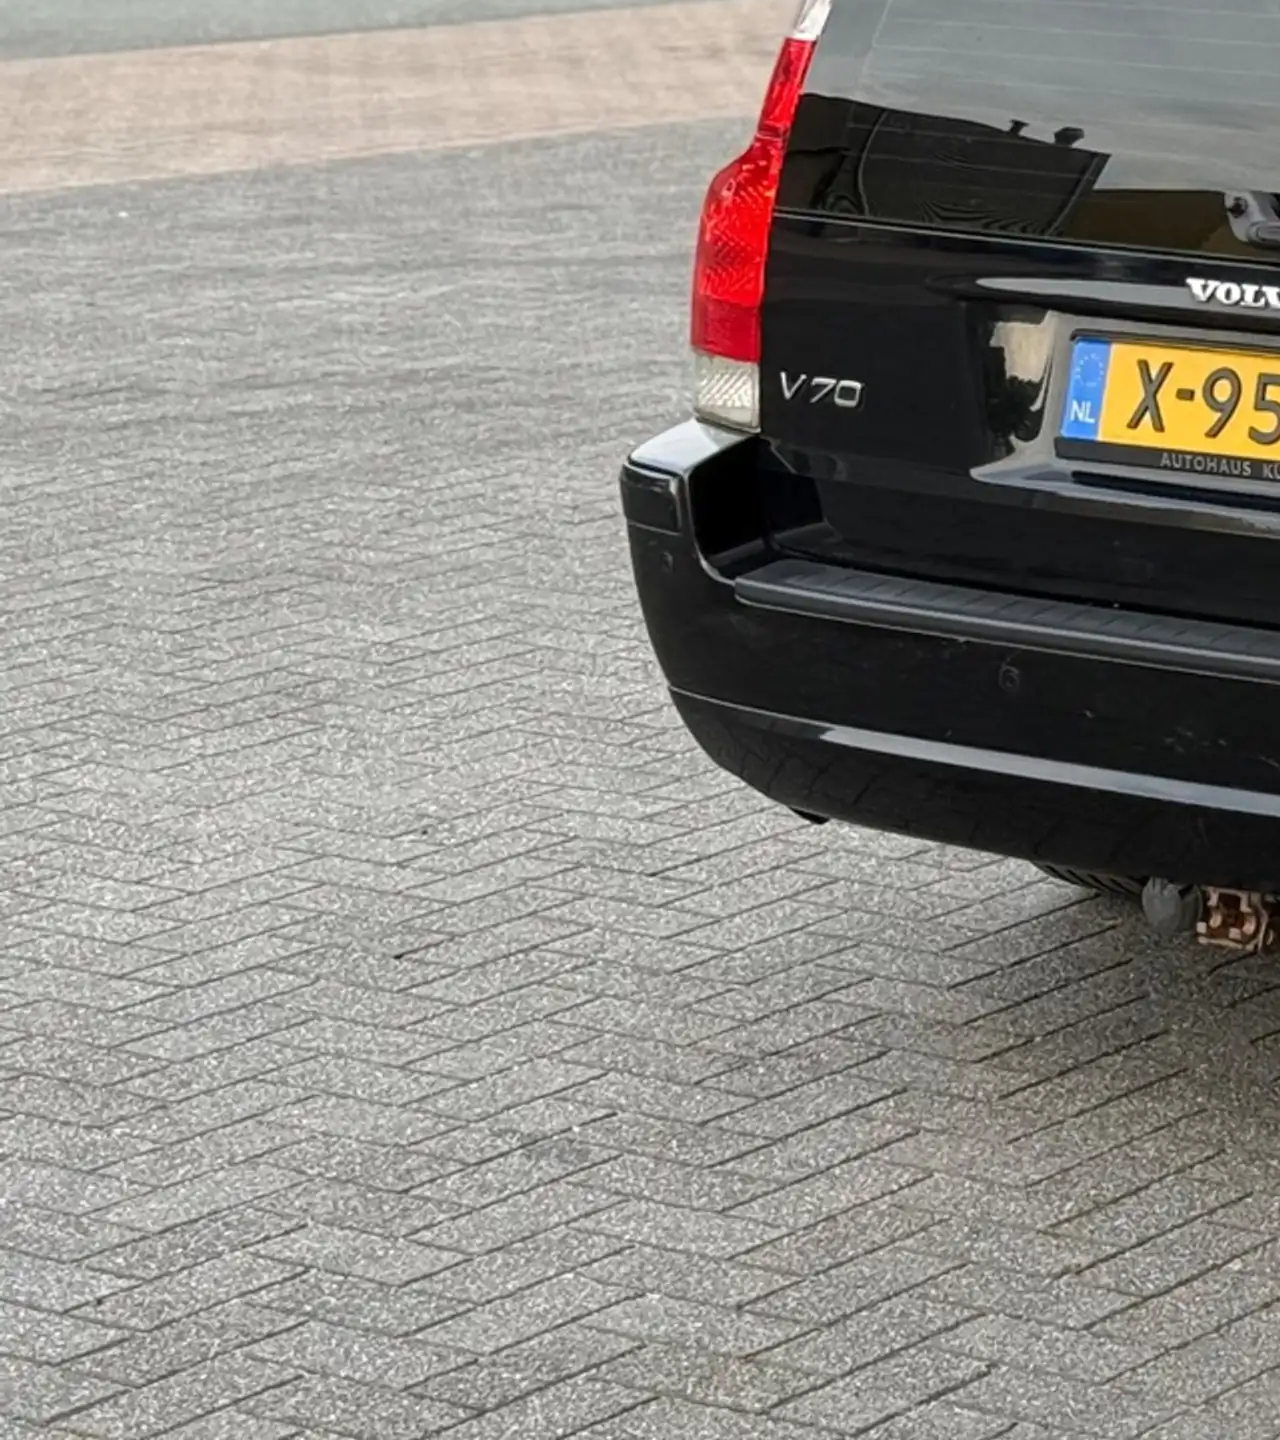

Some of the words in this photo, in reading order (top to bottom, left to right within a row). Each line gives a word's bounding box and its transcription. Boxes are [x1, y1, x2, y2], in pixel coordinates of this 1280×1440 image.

[779, 371, 865, 408] V70
[1069, 399, 1097, 424] NL
[1159, 452, 1252, 477] AUTOHAUS
